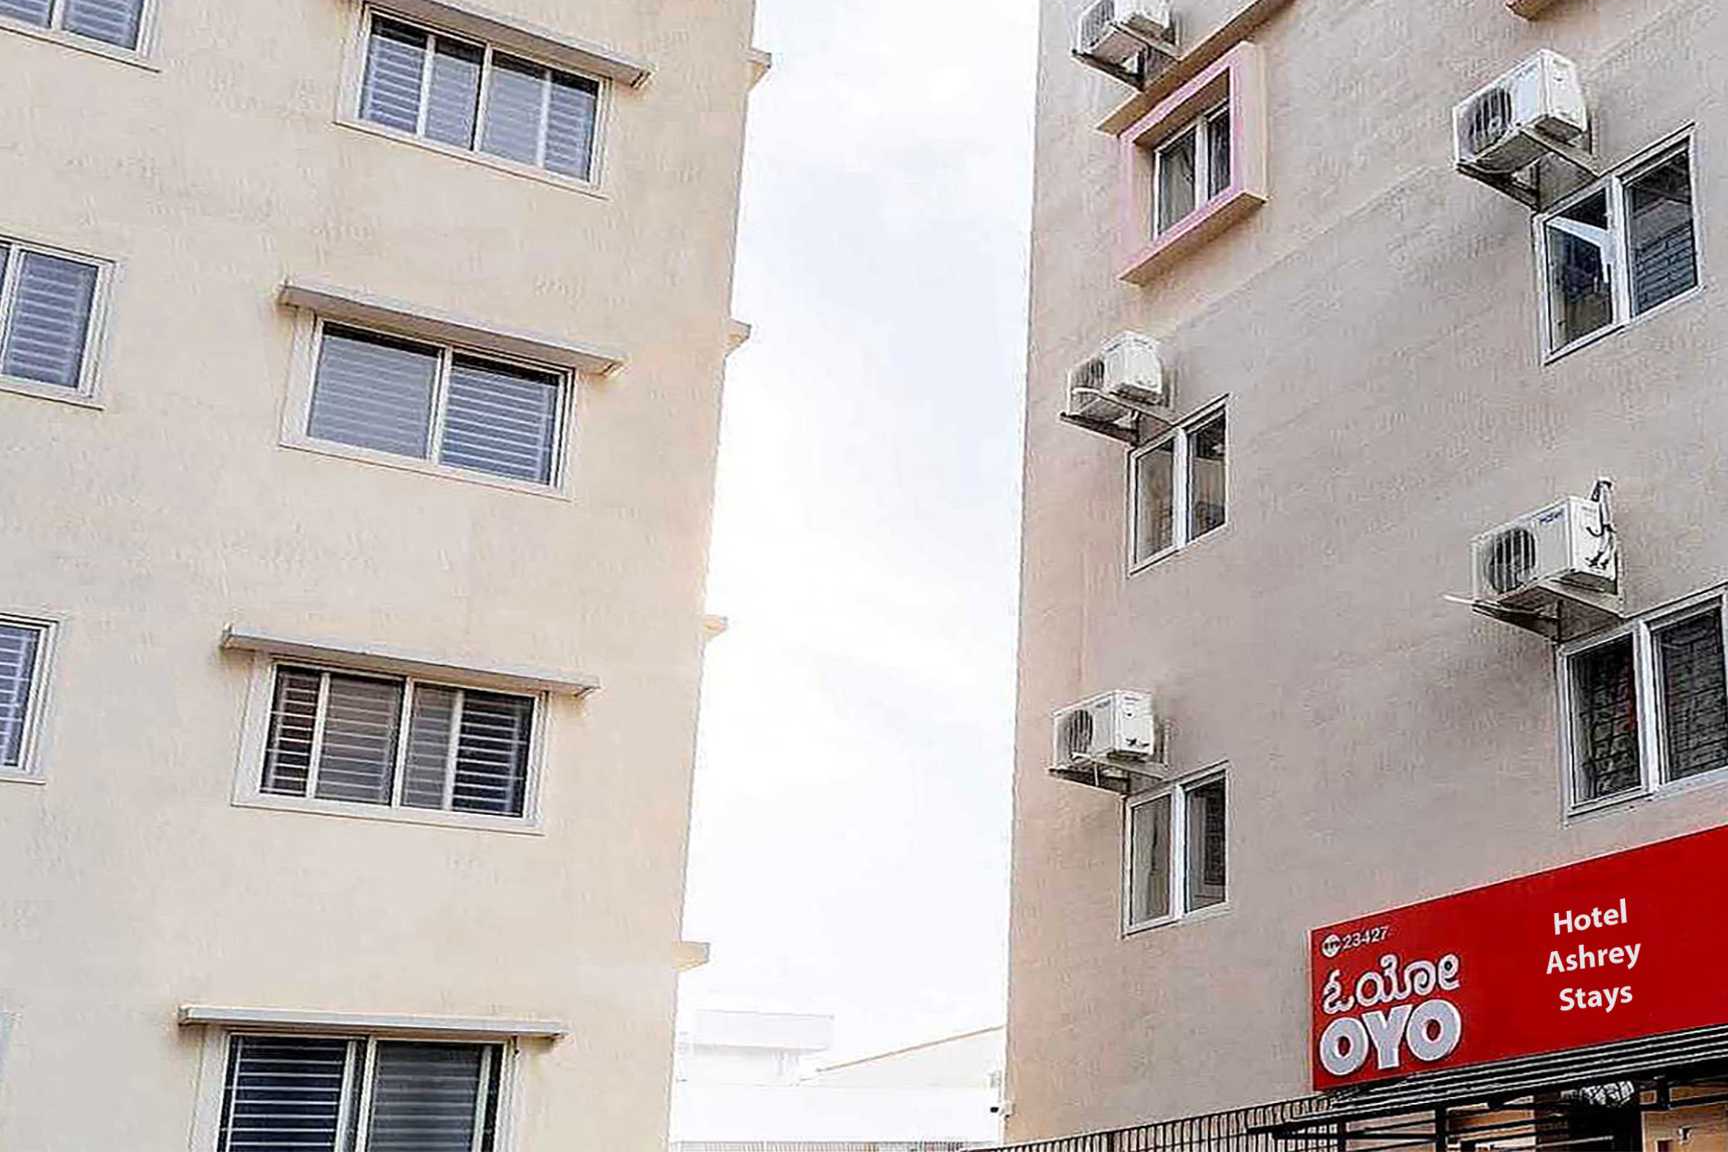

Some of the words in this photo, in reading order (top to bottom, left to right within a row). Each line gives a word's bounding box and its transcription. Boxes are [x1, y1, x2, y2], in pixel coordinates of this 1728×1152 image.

[1553, 898, 1628, 935] Hotel
[1342, 926, 1389, 950] 23427
[1546, 943, 1642, 975] Ashrey
[1323, 954, 1460, 1014] ಓಯೋ
[1559, 984, 1633, 1014] Stays
[1320, 999, 1461, 1076] OYO
